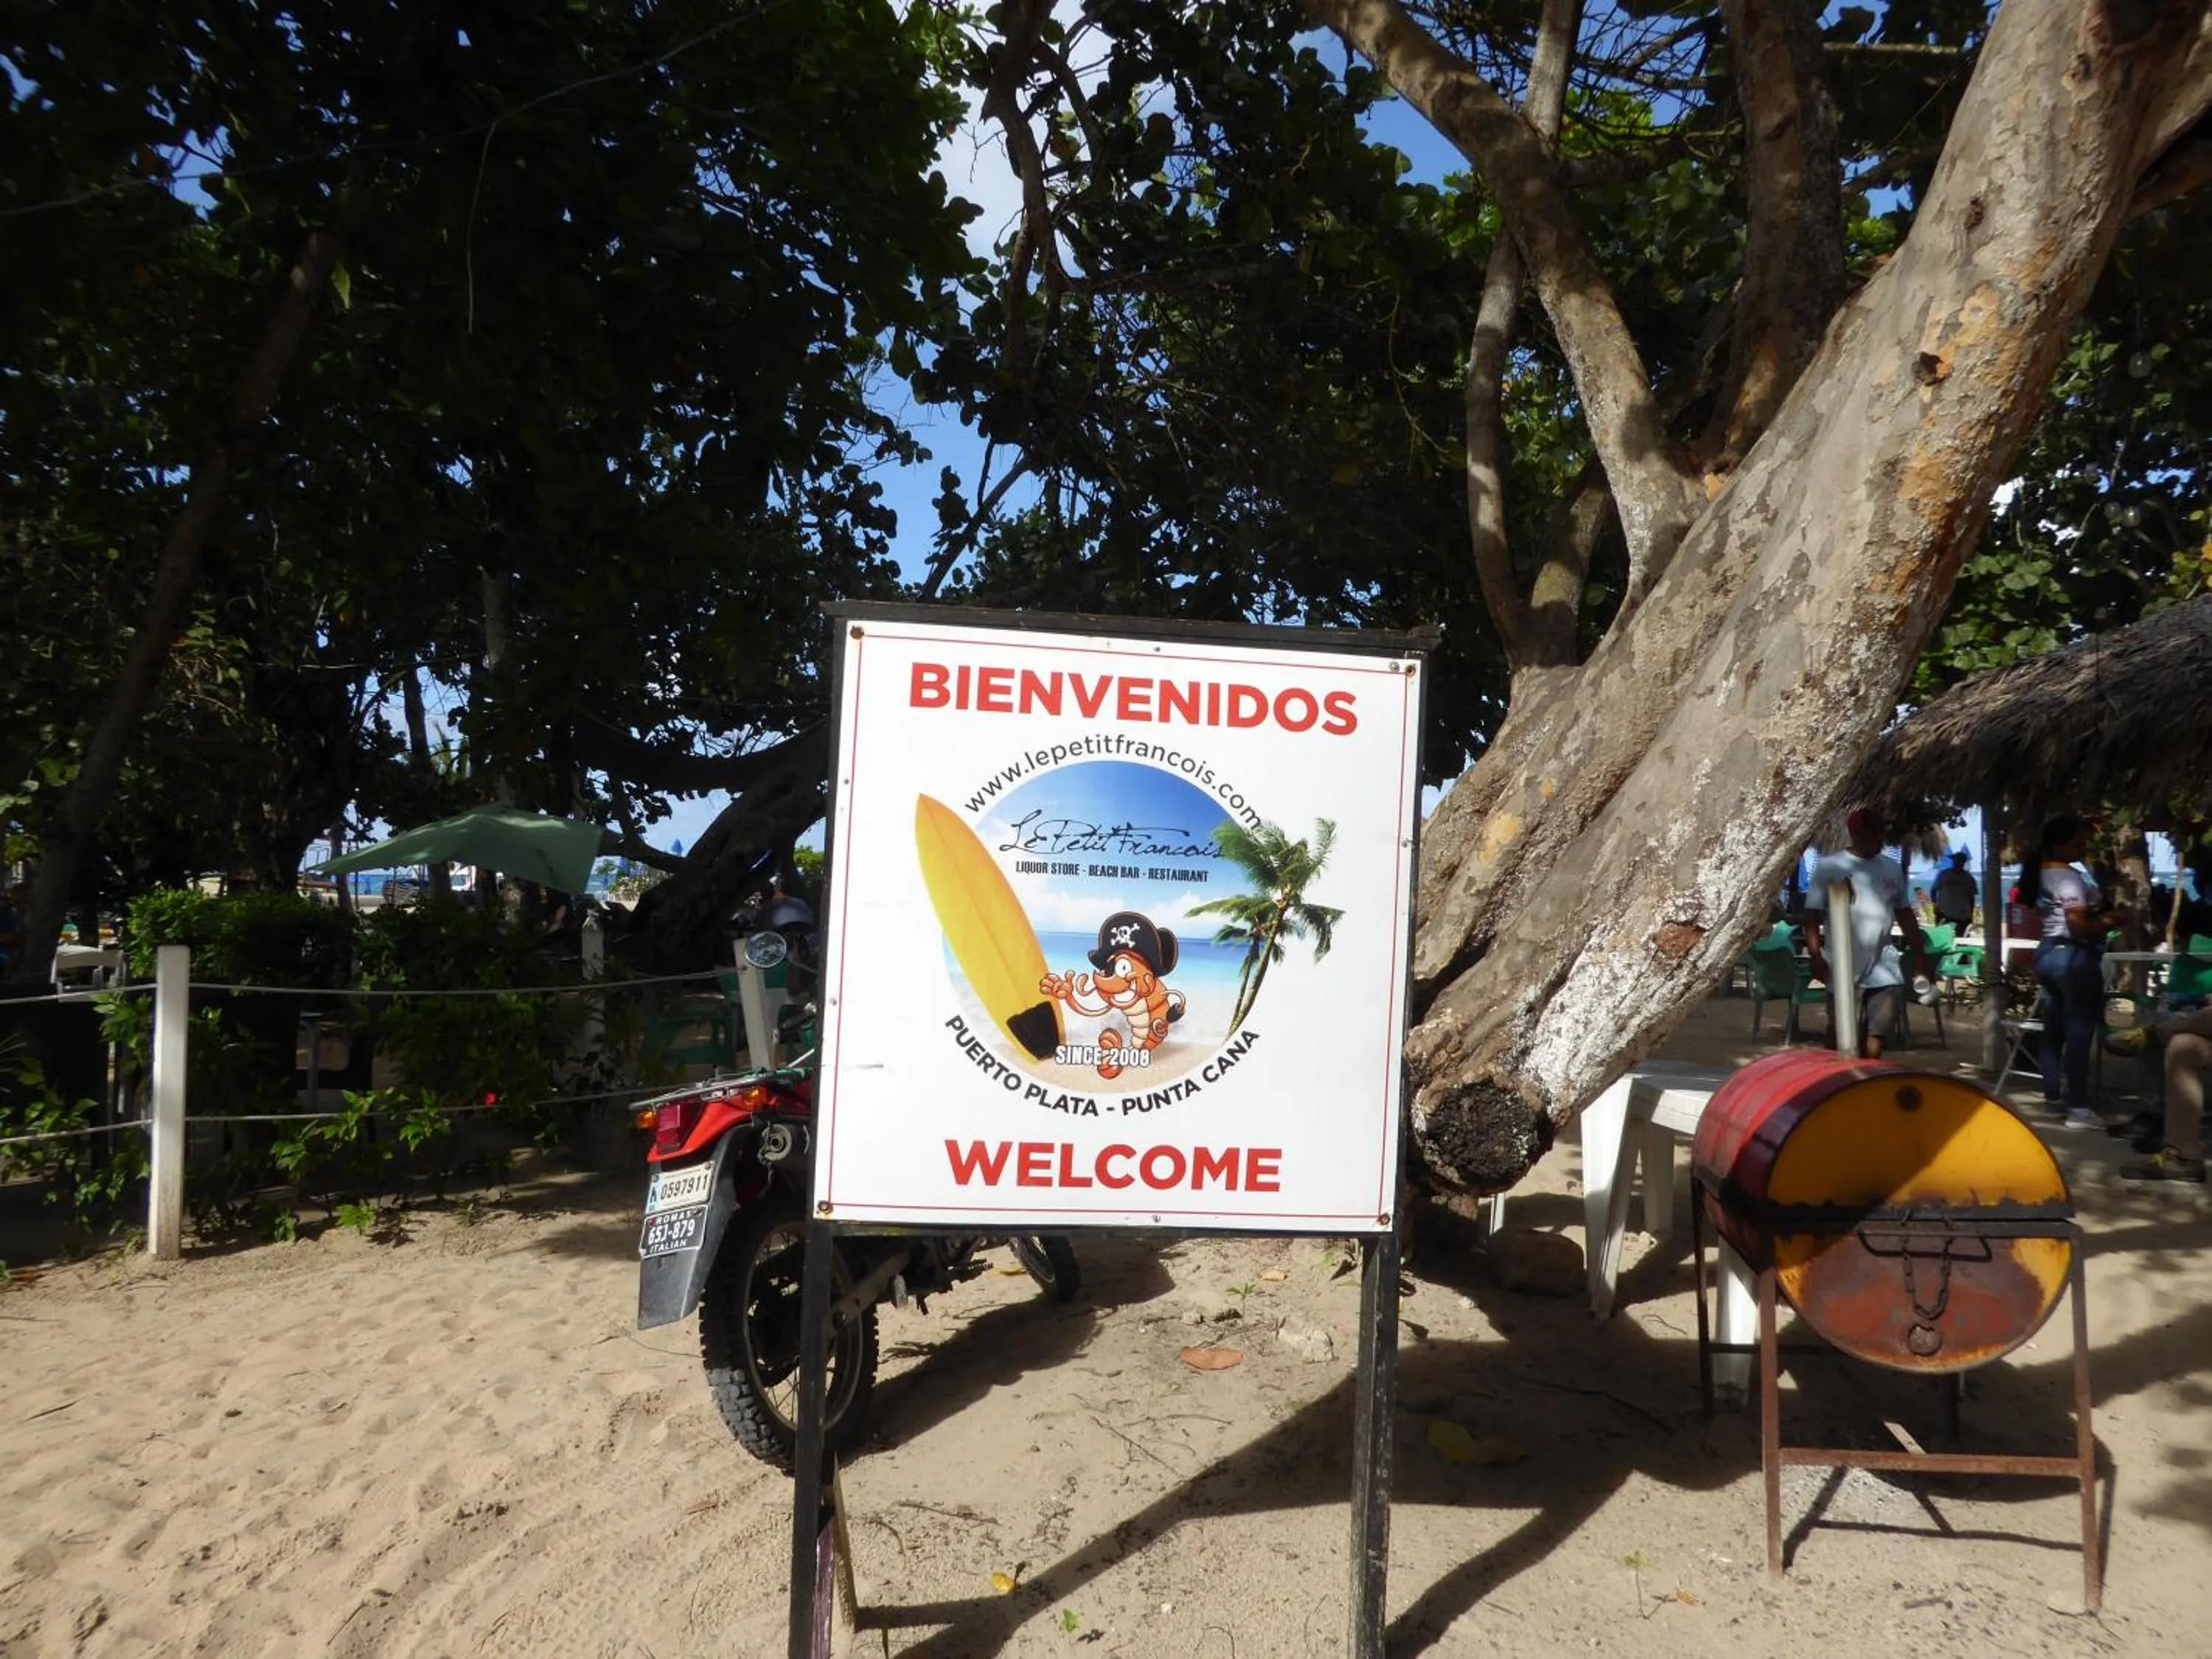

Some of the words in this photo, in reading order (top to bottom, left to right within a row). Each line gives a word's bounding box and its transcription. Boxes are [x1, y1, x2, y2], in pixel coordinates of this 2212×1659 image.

[910, 662, 1357, 736] BIENVENIDOS
[964, 734, 1262, 830] www.lepetitfrancois.com
[1000, 809, 1047, 852] Le
[1015, 860, 1048, 874] LIQUOR
[1051, 862, 1080, 877] STORE
[1088, 863, 1118, 878] BEACH
[1120, 866, 1139, 880] BAR
[1148, 867, 1209, 883] RESTAURANT
[945, 1014, 1021, 1091] PUERTO
[1024, 1083, 1099, 1117] PLATA
[1121, 1077, 1201, 1116] PUNTA
[1203, 1030, 1260, 1083] CANA
[1055, 1045, 1102, 1065] SINCE
[944, 1139, 1282, 1192] WELCOME
[650, 1239, 687, 1254] ITALIAN
